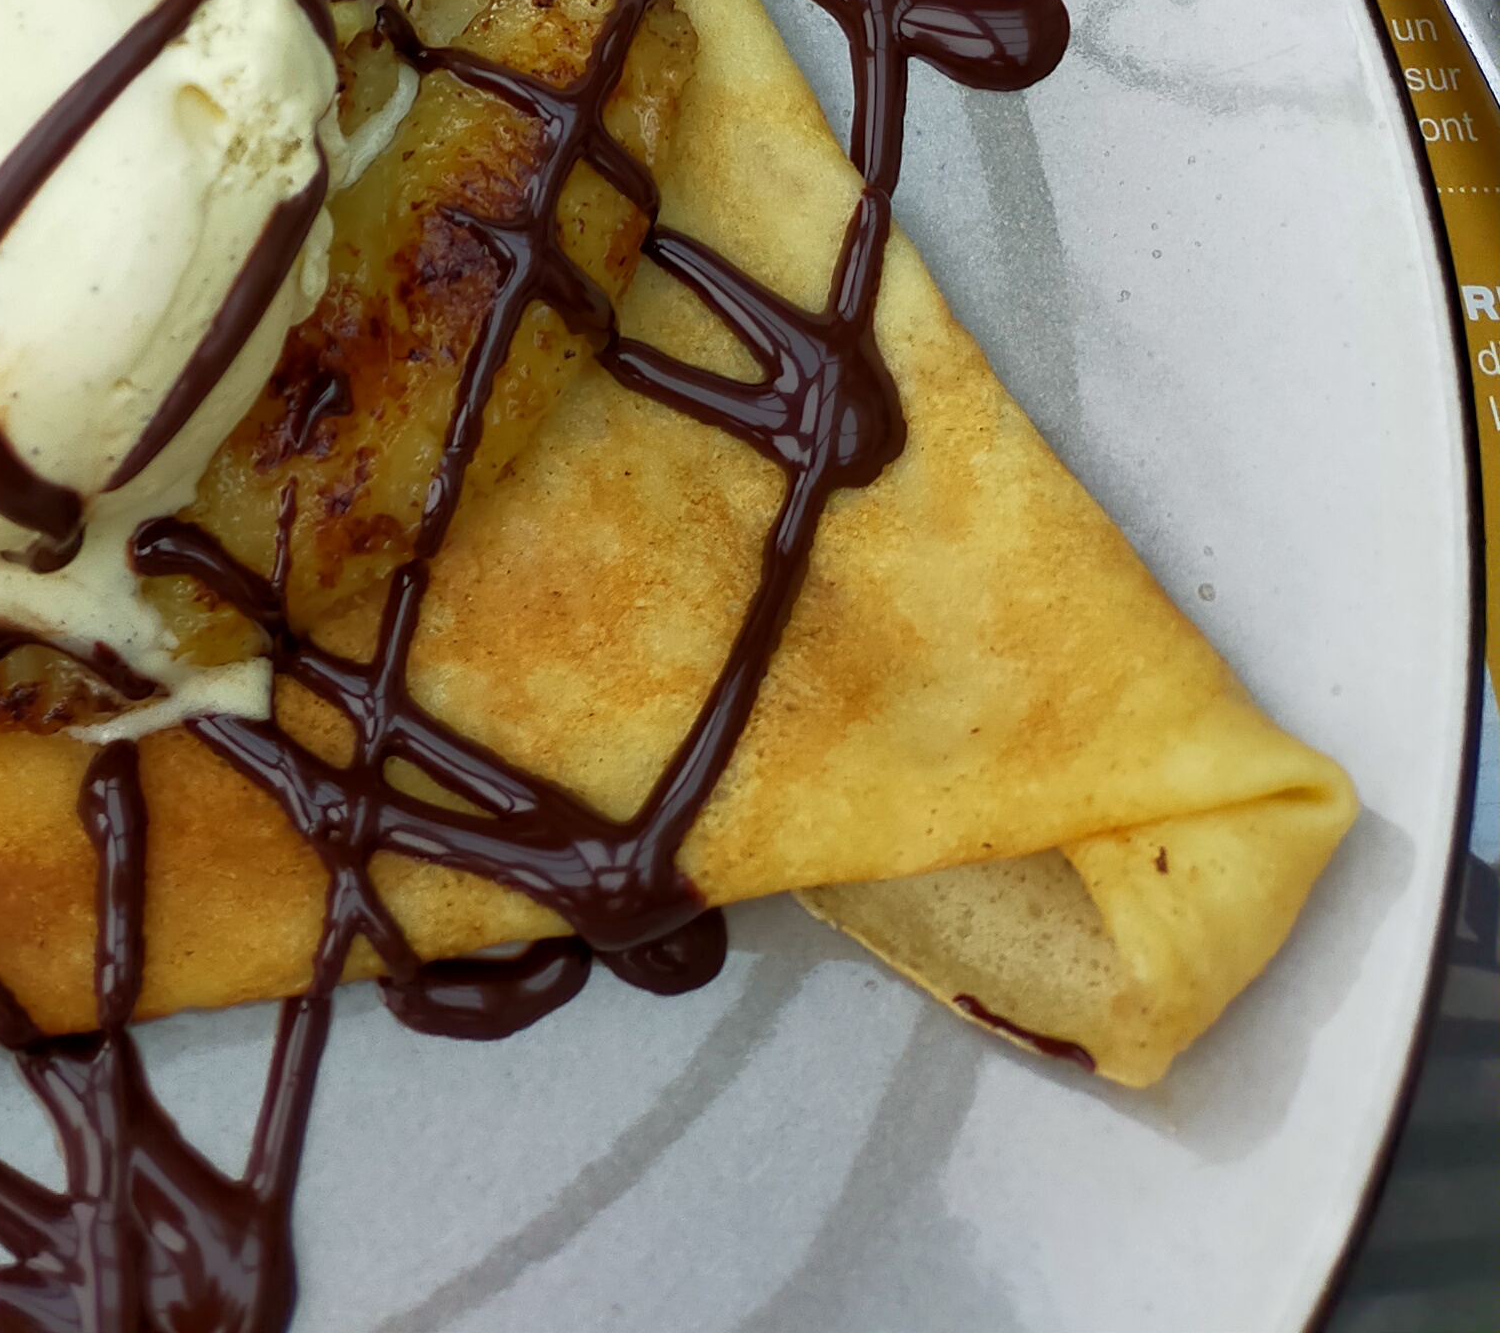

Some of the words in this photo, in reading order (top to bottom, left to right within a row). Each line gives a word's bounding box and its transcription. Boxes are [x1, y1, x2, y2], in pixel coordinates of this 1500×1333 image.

[1391, 18, 1438, 42] un
[1404, 66, 1462, 92] sur
[1418, 111, 1479, 143] ont
